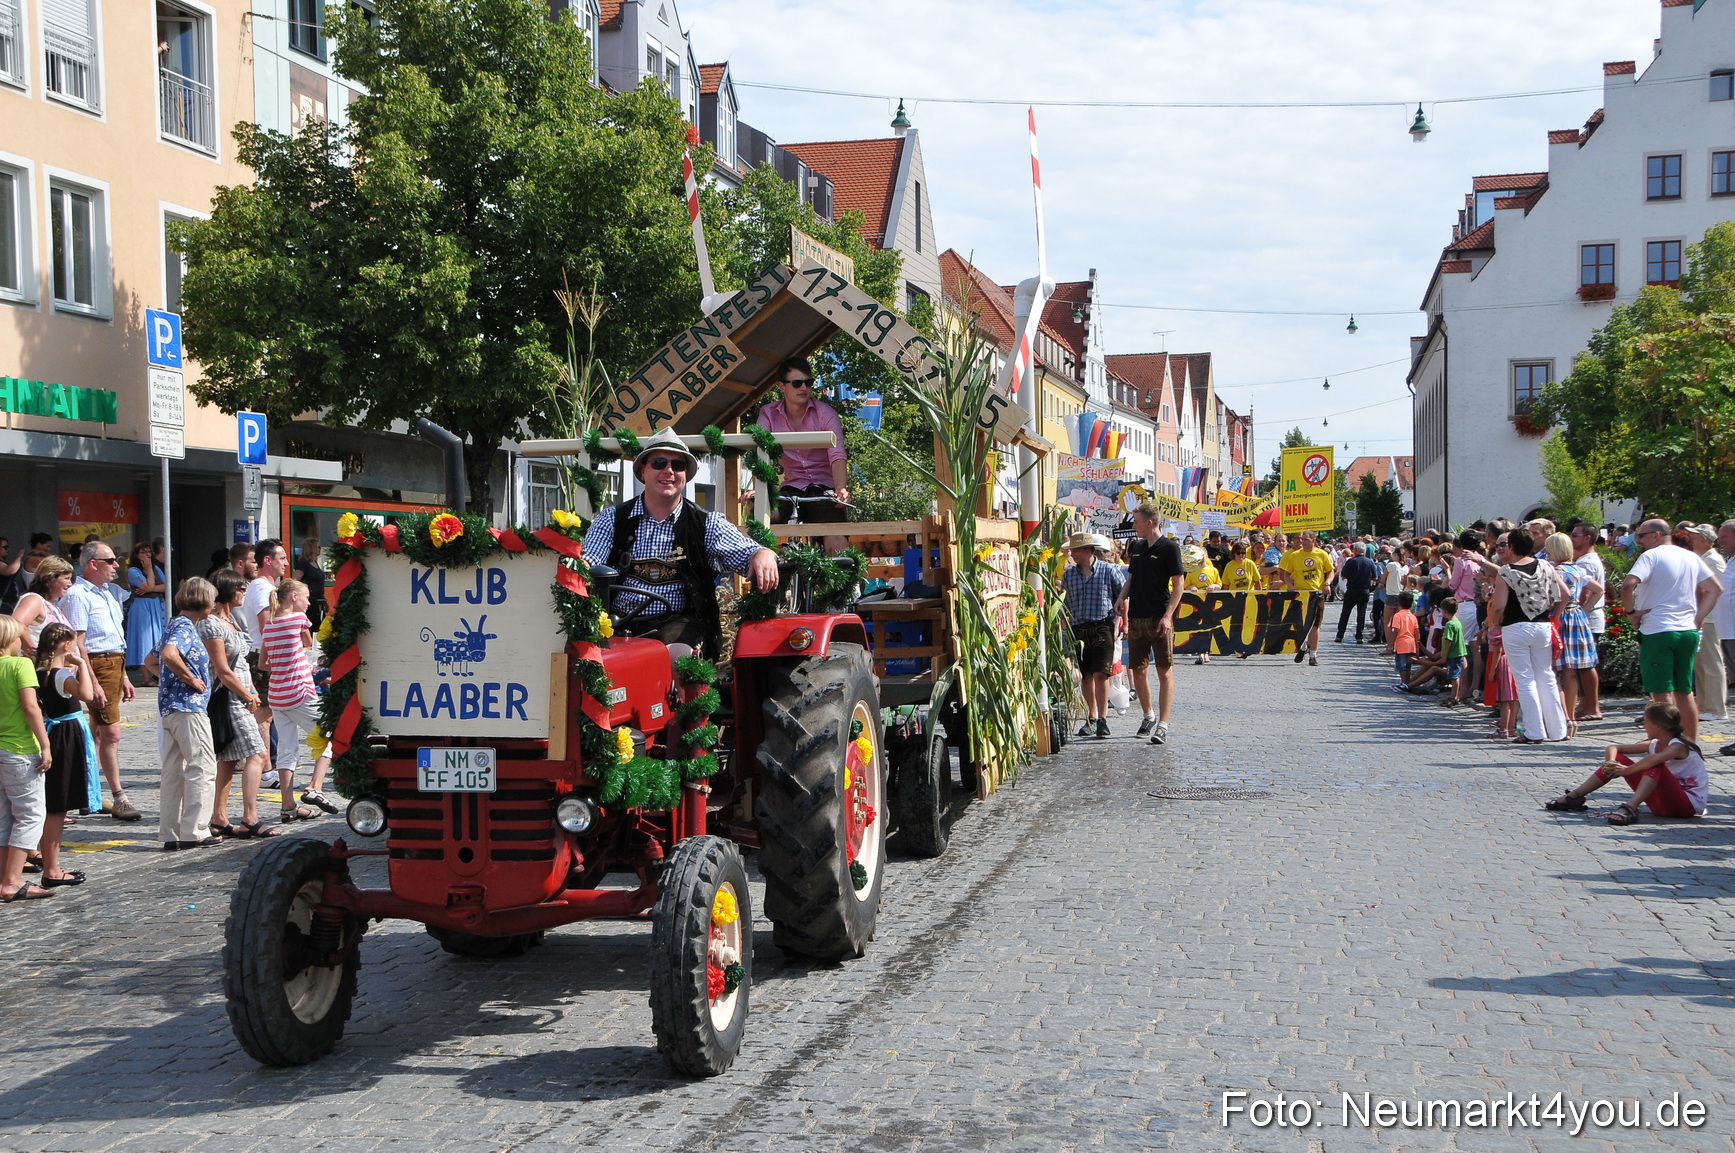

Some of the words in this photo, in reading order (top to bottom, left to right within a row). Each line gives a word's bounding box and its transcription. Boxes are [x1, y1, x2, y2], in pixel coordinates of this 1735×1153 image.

[154, 316, 173, 358] P
[645, 344, 738, 429] AABER
[243, 418, 260, 458] P
[1057, 456, 1085, 466] NICHT
[1080, 466, 1125, 480] SCHLAFEN
[1285, 480, 1297, 492] JA
[1285, 503, 1309, 517] NEIN
[410, 567, 508, 606] KLJB
[379, 681, 529, 721] LAABER
[444, 751, 470, 769] NM
[424, 771, 448, 789] FF
[454, 771, 489, 789] 105
